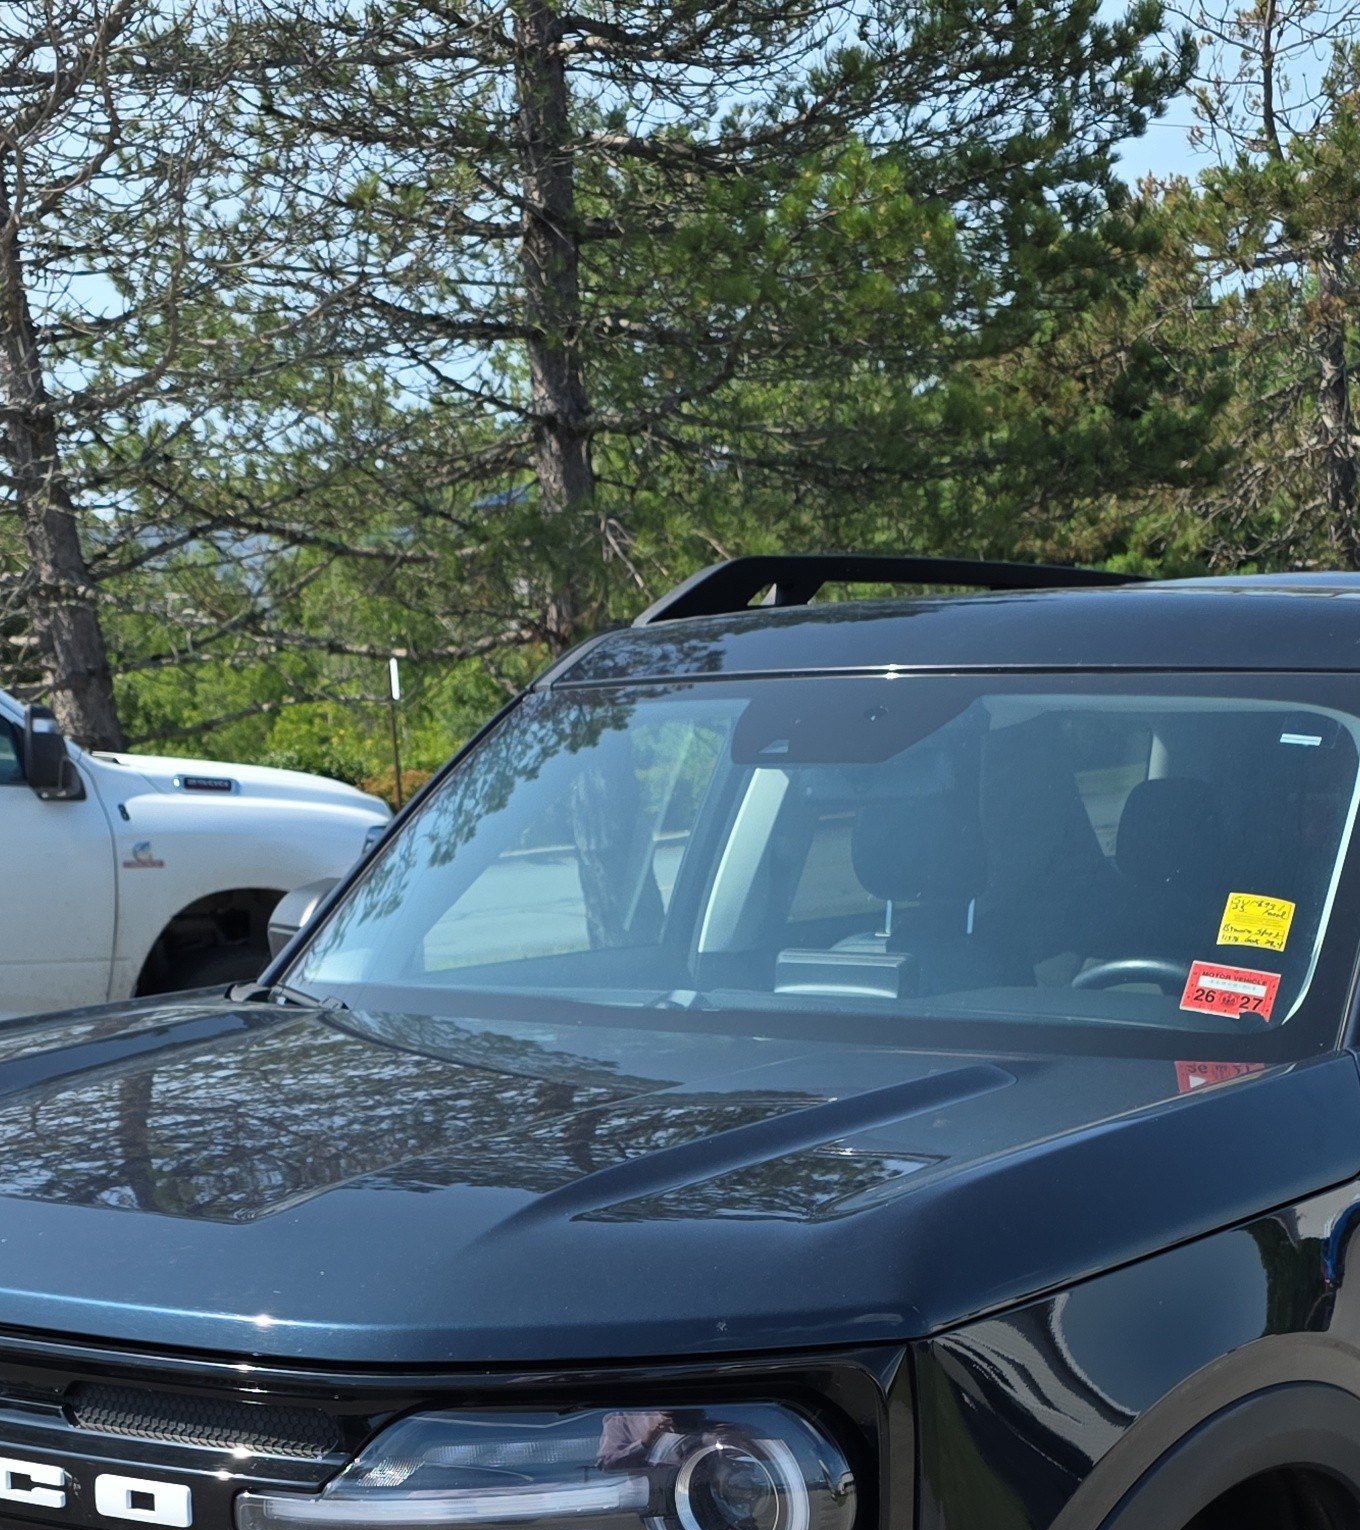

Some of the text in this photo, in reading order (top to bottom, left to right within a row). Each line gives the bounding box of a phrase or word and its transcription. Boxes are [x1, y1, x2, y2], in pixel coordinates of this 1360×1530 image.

[1202, 971, 1232, 980] MOTOR
[1234, 975, 1268, 986] VEHICLE
[1193, 988, 1216, 1003] 26
[1239, 996, 1264, 1011] 27
